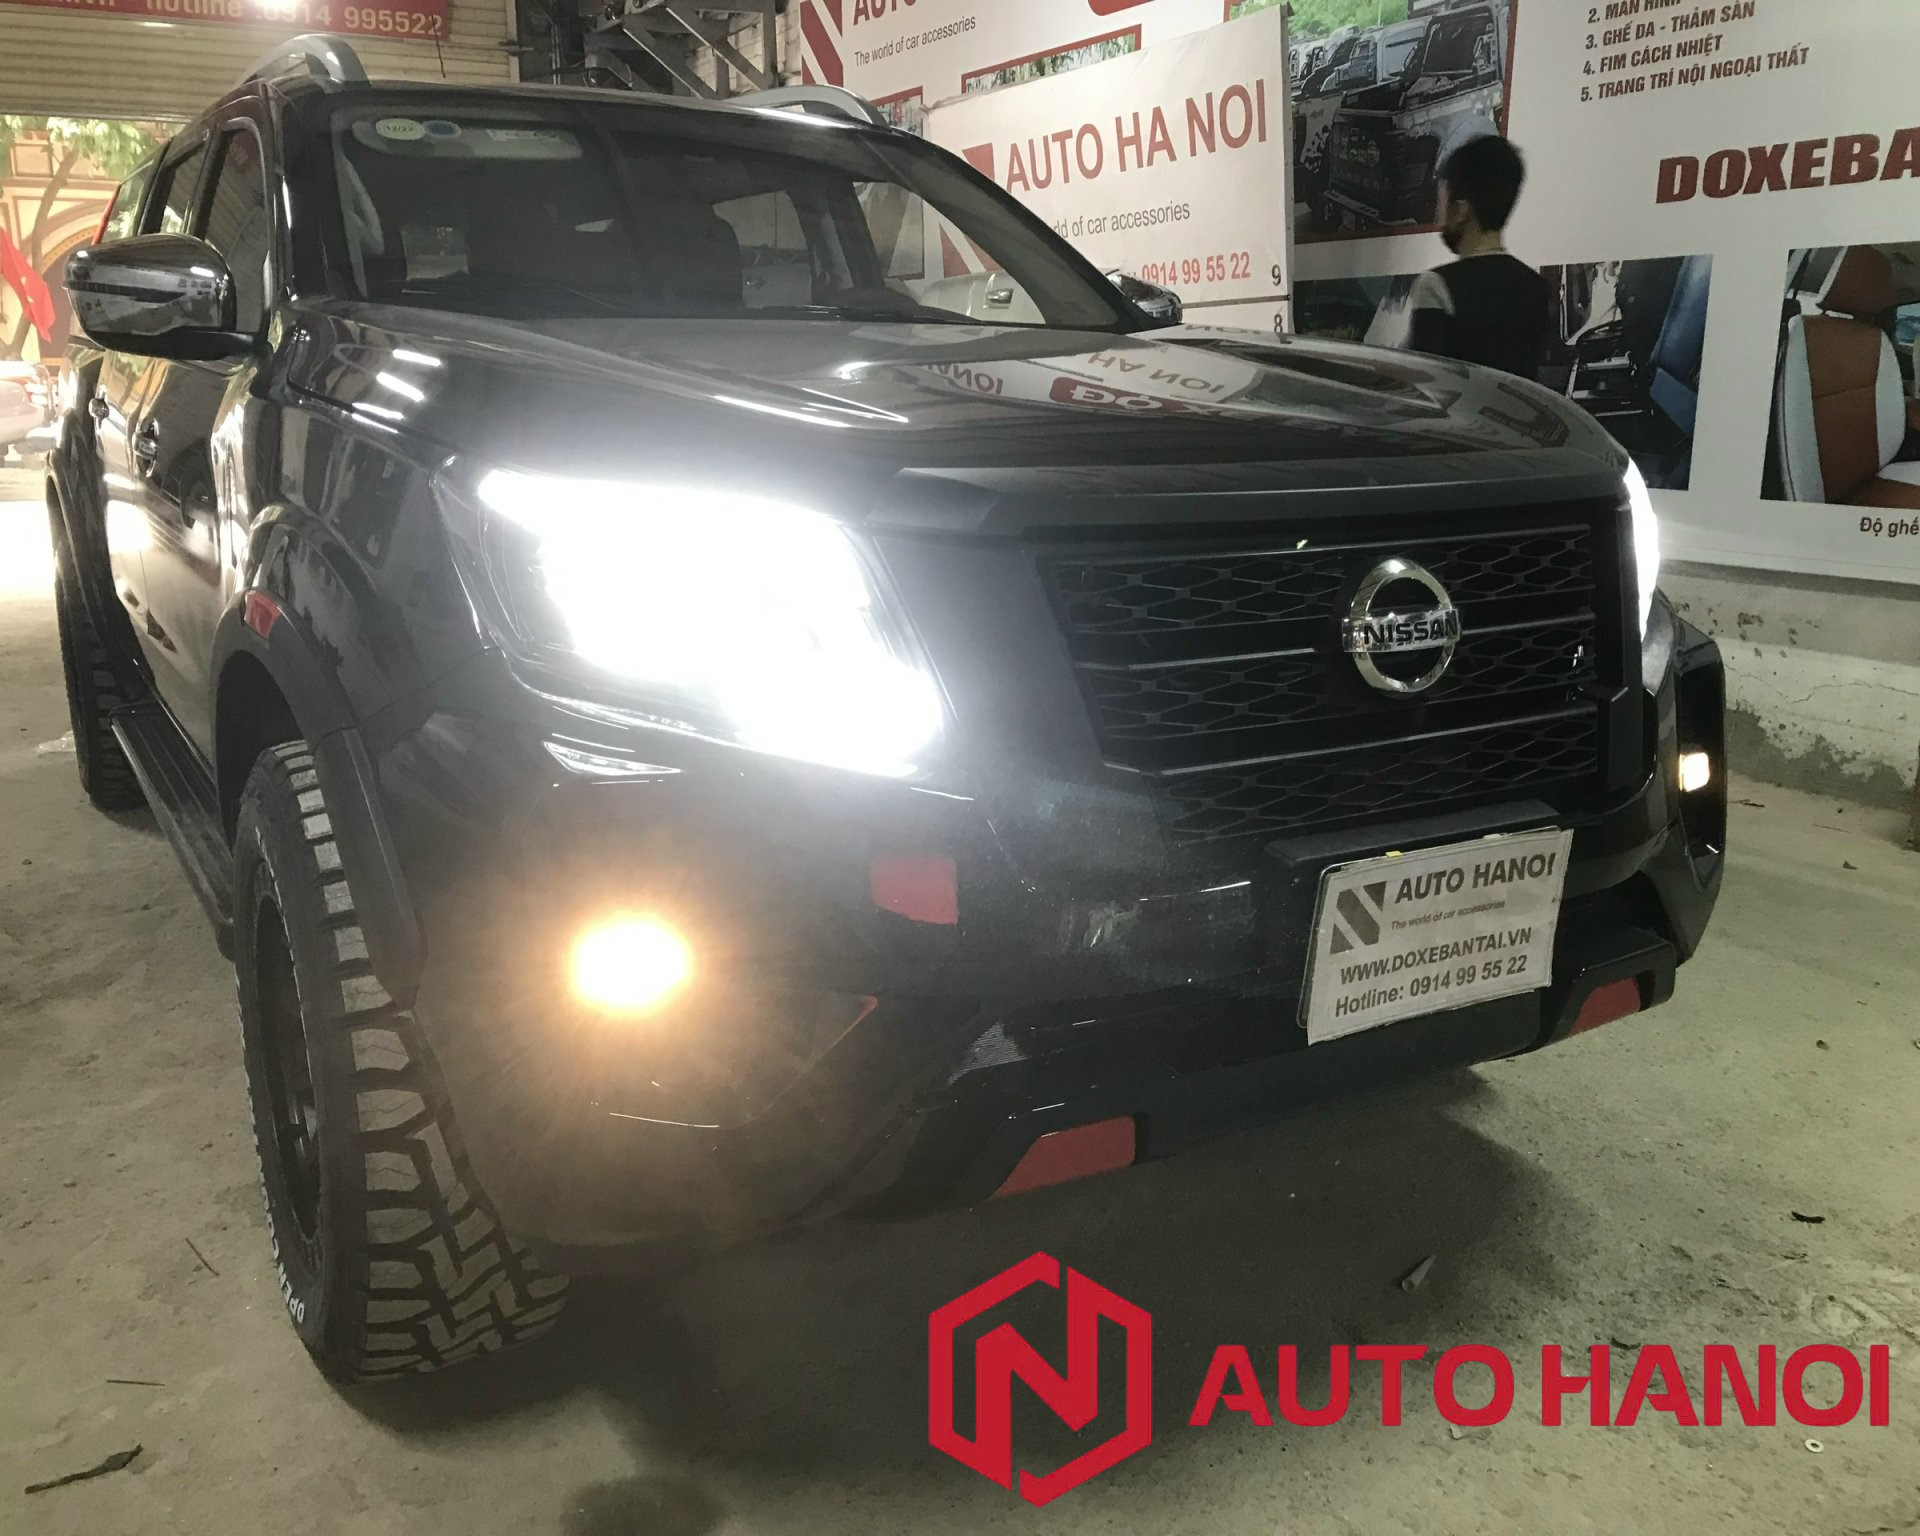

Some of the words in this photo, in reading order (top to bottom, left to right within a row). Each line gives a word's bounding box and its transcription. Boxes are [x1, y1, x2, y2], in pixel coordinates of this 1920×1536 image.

[344, 6, 443, 36] 995522
[1585, 34, 1597, 49] 3.
[1603, 20, 1633, 46] GHẾ
[1635, 21, 1655, 40] DA
[1671, 6, 1716, 32] THẢM
[1588, 8, 1600, 24] 2.
[854, 51, 870, 66] The
[872, 40, 894, 60] world
[895, 36, 905, 53] of
[905, 35, 920, 50] car
[921, 16, 976, 45] accessories
[1582, 60, 1595, 76] 4.
[1600, 54, 1627, 72] FIM
[1630, 46, 1672, 67] CÁCH
[1676, 33, 1723, 57] NHIỆT
[1580, 86, 1593, 102] 5.
[1598, 76, 1645, 99] TRANG
[1650, 67, 1674, 90] TRÍ
[1678, 63, 1706, 86] NỘI
[1710, 56, 1761, 79] NGOẠI
[1767, 42, 1810, 70] THẤT
[1006, 123, 1104, 193] AUTO
[1115, 105, 1177, 172] HA
[1185, 79, 1267, 157] NOI
[1071, 214, 1084, 237] of
[1087, 218, 1107, 235] car
[1111, 200, 1191, 232] accessories
[1182, 258, 1201, 284] 99
[1206, 255, 1226, 282] 55
[1230, 251, 1251, 279] 22
[1271, 264, 1282, 286] 9
[1859, 516, 1884, 537] Độ
[1887, 516, 1920, 538] ghế
[1363, 609, 1458, 647] NISSAN
[1394, 867, 1465, 904] AUTO
[1472, 852, 1557, 889] HANOI
[1340, 926, 1532, 985] WWW.DOXEBANTAI.VN
[1335, 989, 1404, 1017] Hotline:
[1409, 970, 1451, 997] 0914
[1455, 965, 1476, 986] 99
[1481, 960, 1503, 981] 55
[1506, 954, 1528, 976] 22
